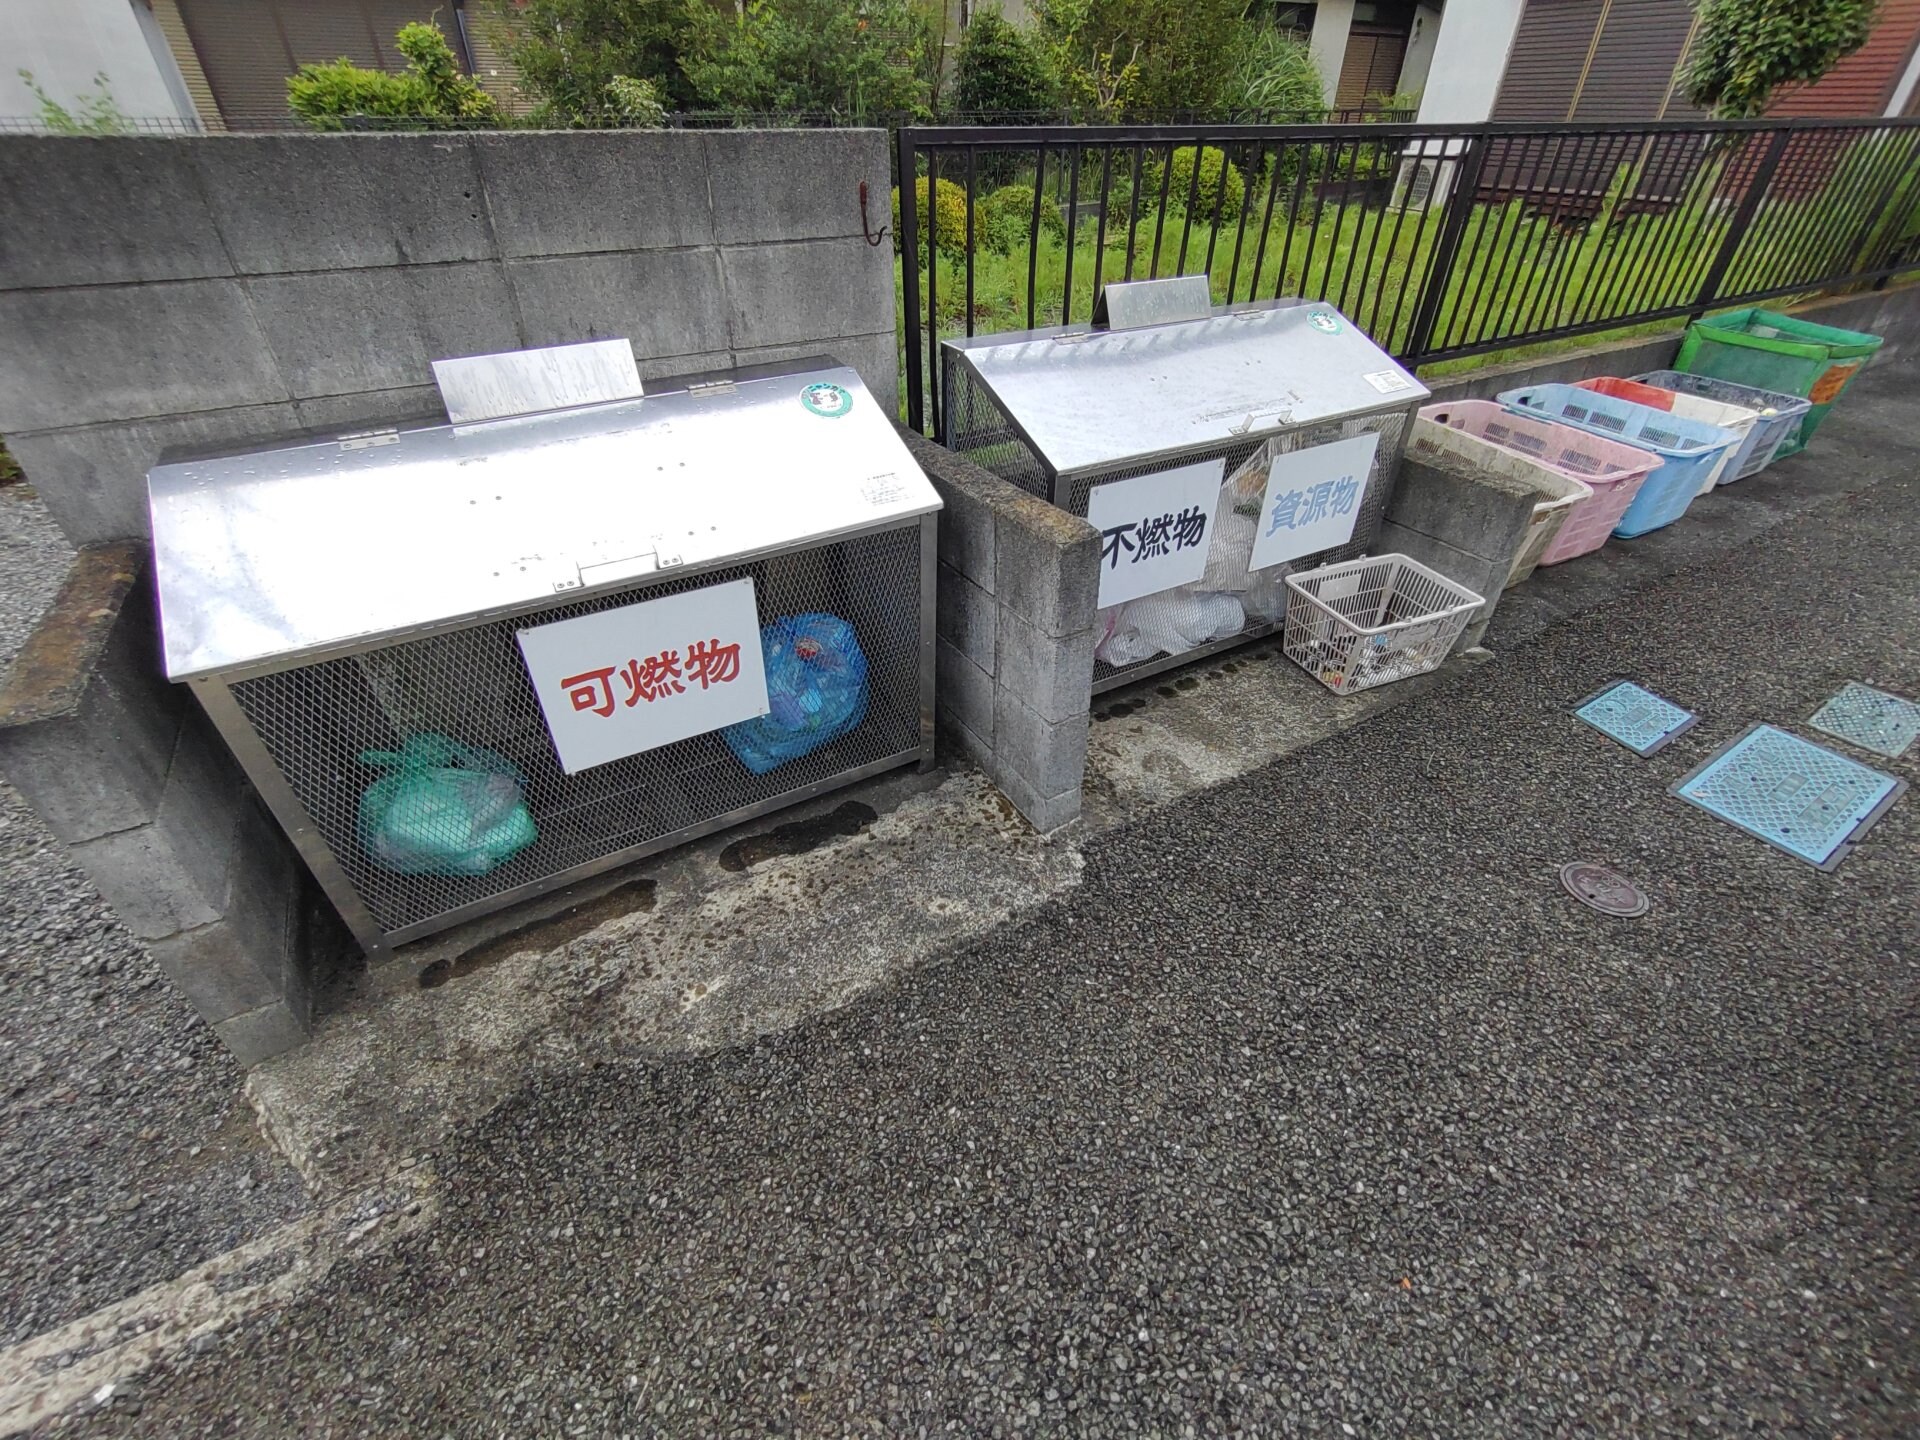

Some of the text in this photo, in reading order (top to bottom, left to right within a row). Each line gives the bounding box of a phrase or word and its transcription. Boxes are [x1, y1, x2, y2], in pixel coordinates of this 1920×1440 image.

[1102, 506, 1207, 570] 不燃物
[1265, 475, 1359, 538] 資源物
[560, 639, 740, 718] 可燃物
